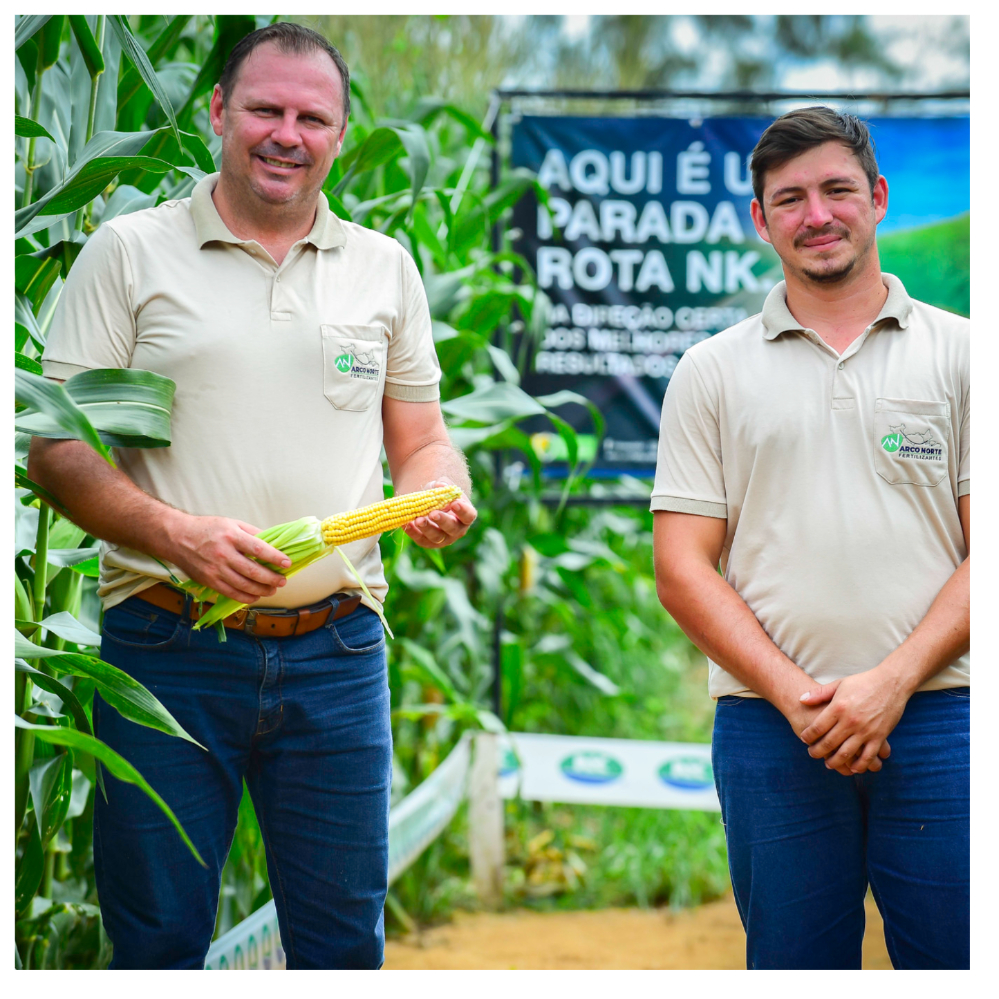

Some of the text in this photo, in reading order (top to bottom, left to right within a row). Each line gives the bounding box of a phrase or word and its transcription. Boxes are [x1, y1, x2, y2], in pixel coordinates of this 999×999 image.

[537, 148, 663, 195] AQUI
[676, 140, 711, 195] É
[537, 197, 745, 244] PARADA
[536, 246, 675, 293] ROTA
[899, 445, 942, 455] ARCO NORTE
